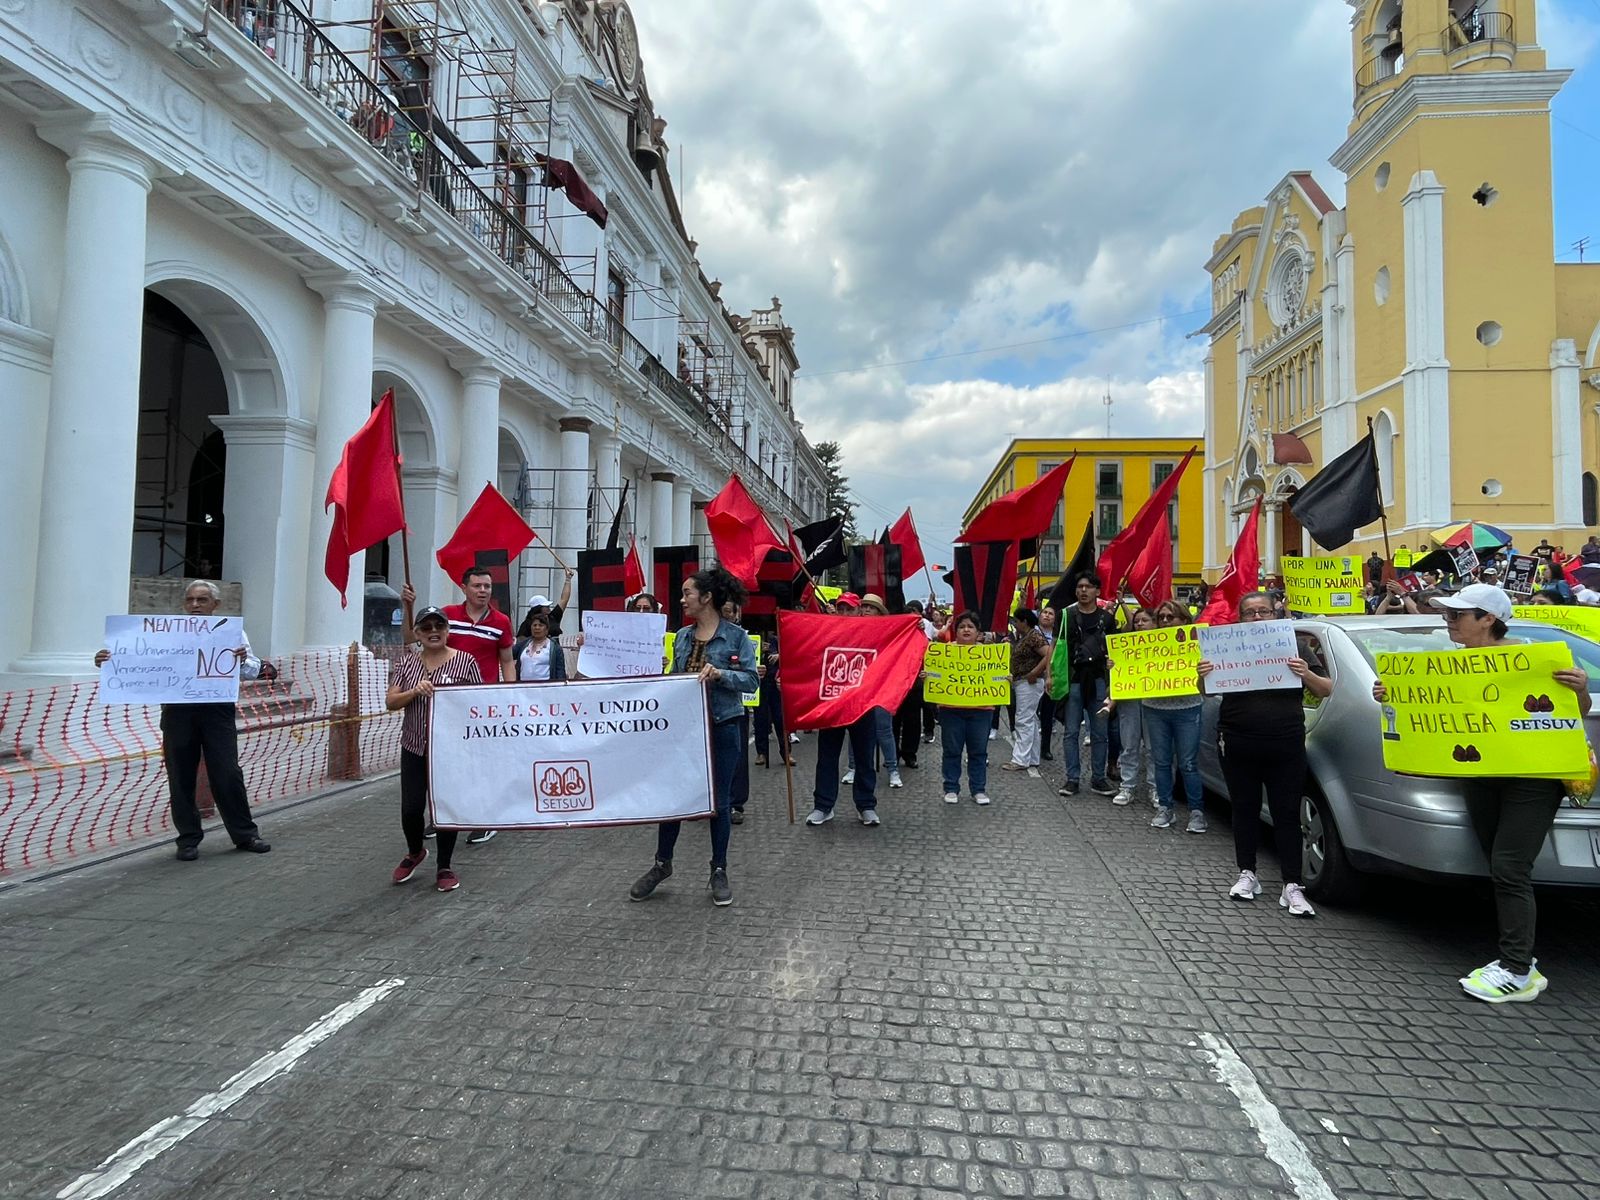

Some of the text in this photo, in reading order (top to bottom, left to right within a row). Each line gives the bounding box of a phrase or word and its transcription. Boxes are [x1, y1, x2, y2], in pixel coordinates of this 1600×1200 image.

[1324, 577, 1363, 588] SALARIAL
[1111, 632, 1168, 649] ESTADO
[1201, 627, 1247, 641] Nuestro
[1122, 642, 1200, 660] PETROLER
[1235, 642, 1271, 654] abajo
[1275, 638, 1291, 648] del
[197, 647, 237, 676] NO
[925, 658, 1009, 672] CALLADO JAMAS
[1115, 658, 1198, 678] Y EL PUEBL
[1211, 659, 1251, 671] alario
[1379, 652, 1530, 676] 20% AUMENTO
[615, 664, 655, 676] SETSUV
[1114, 681, 1136, 692] SIN
[1216, 674, 1283, 688] SETSUV UV
[928, 681, 1006, 698] ESCUCHADO
[1482, 683, 1500, 702] O
[599, 698, 659, 715] UNIDO
[463, 717, 669, 740] JAMÁS SERÁ VENCIDO
[1409, 712, 1497, 734] HUELGA
[1510, 719, 1577, 730] SETSUV
[542, 797, 588, 810] SETSUV
